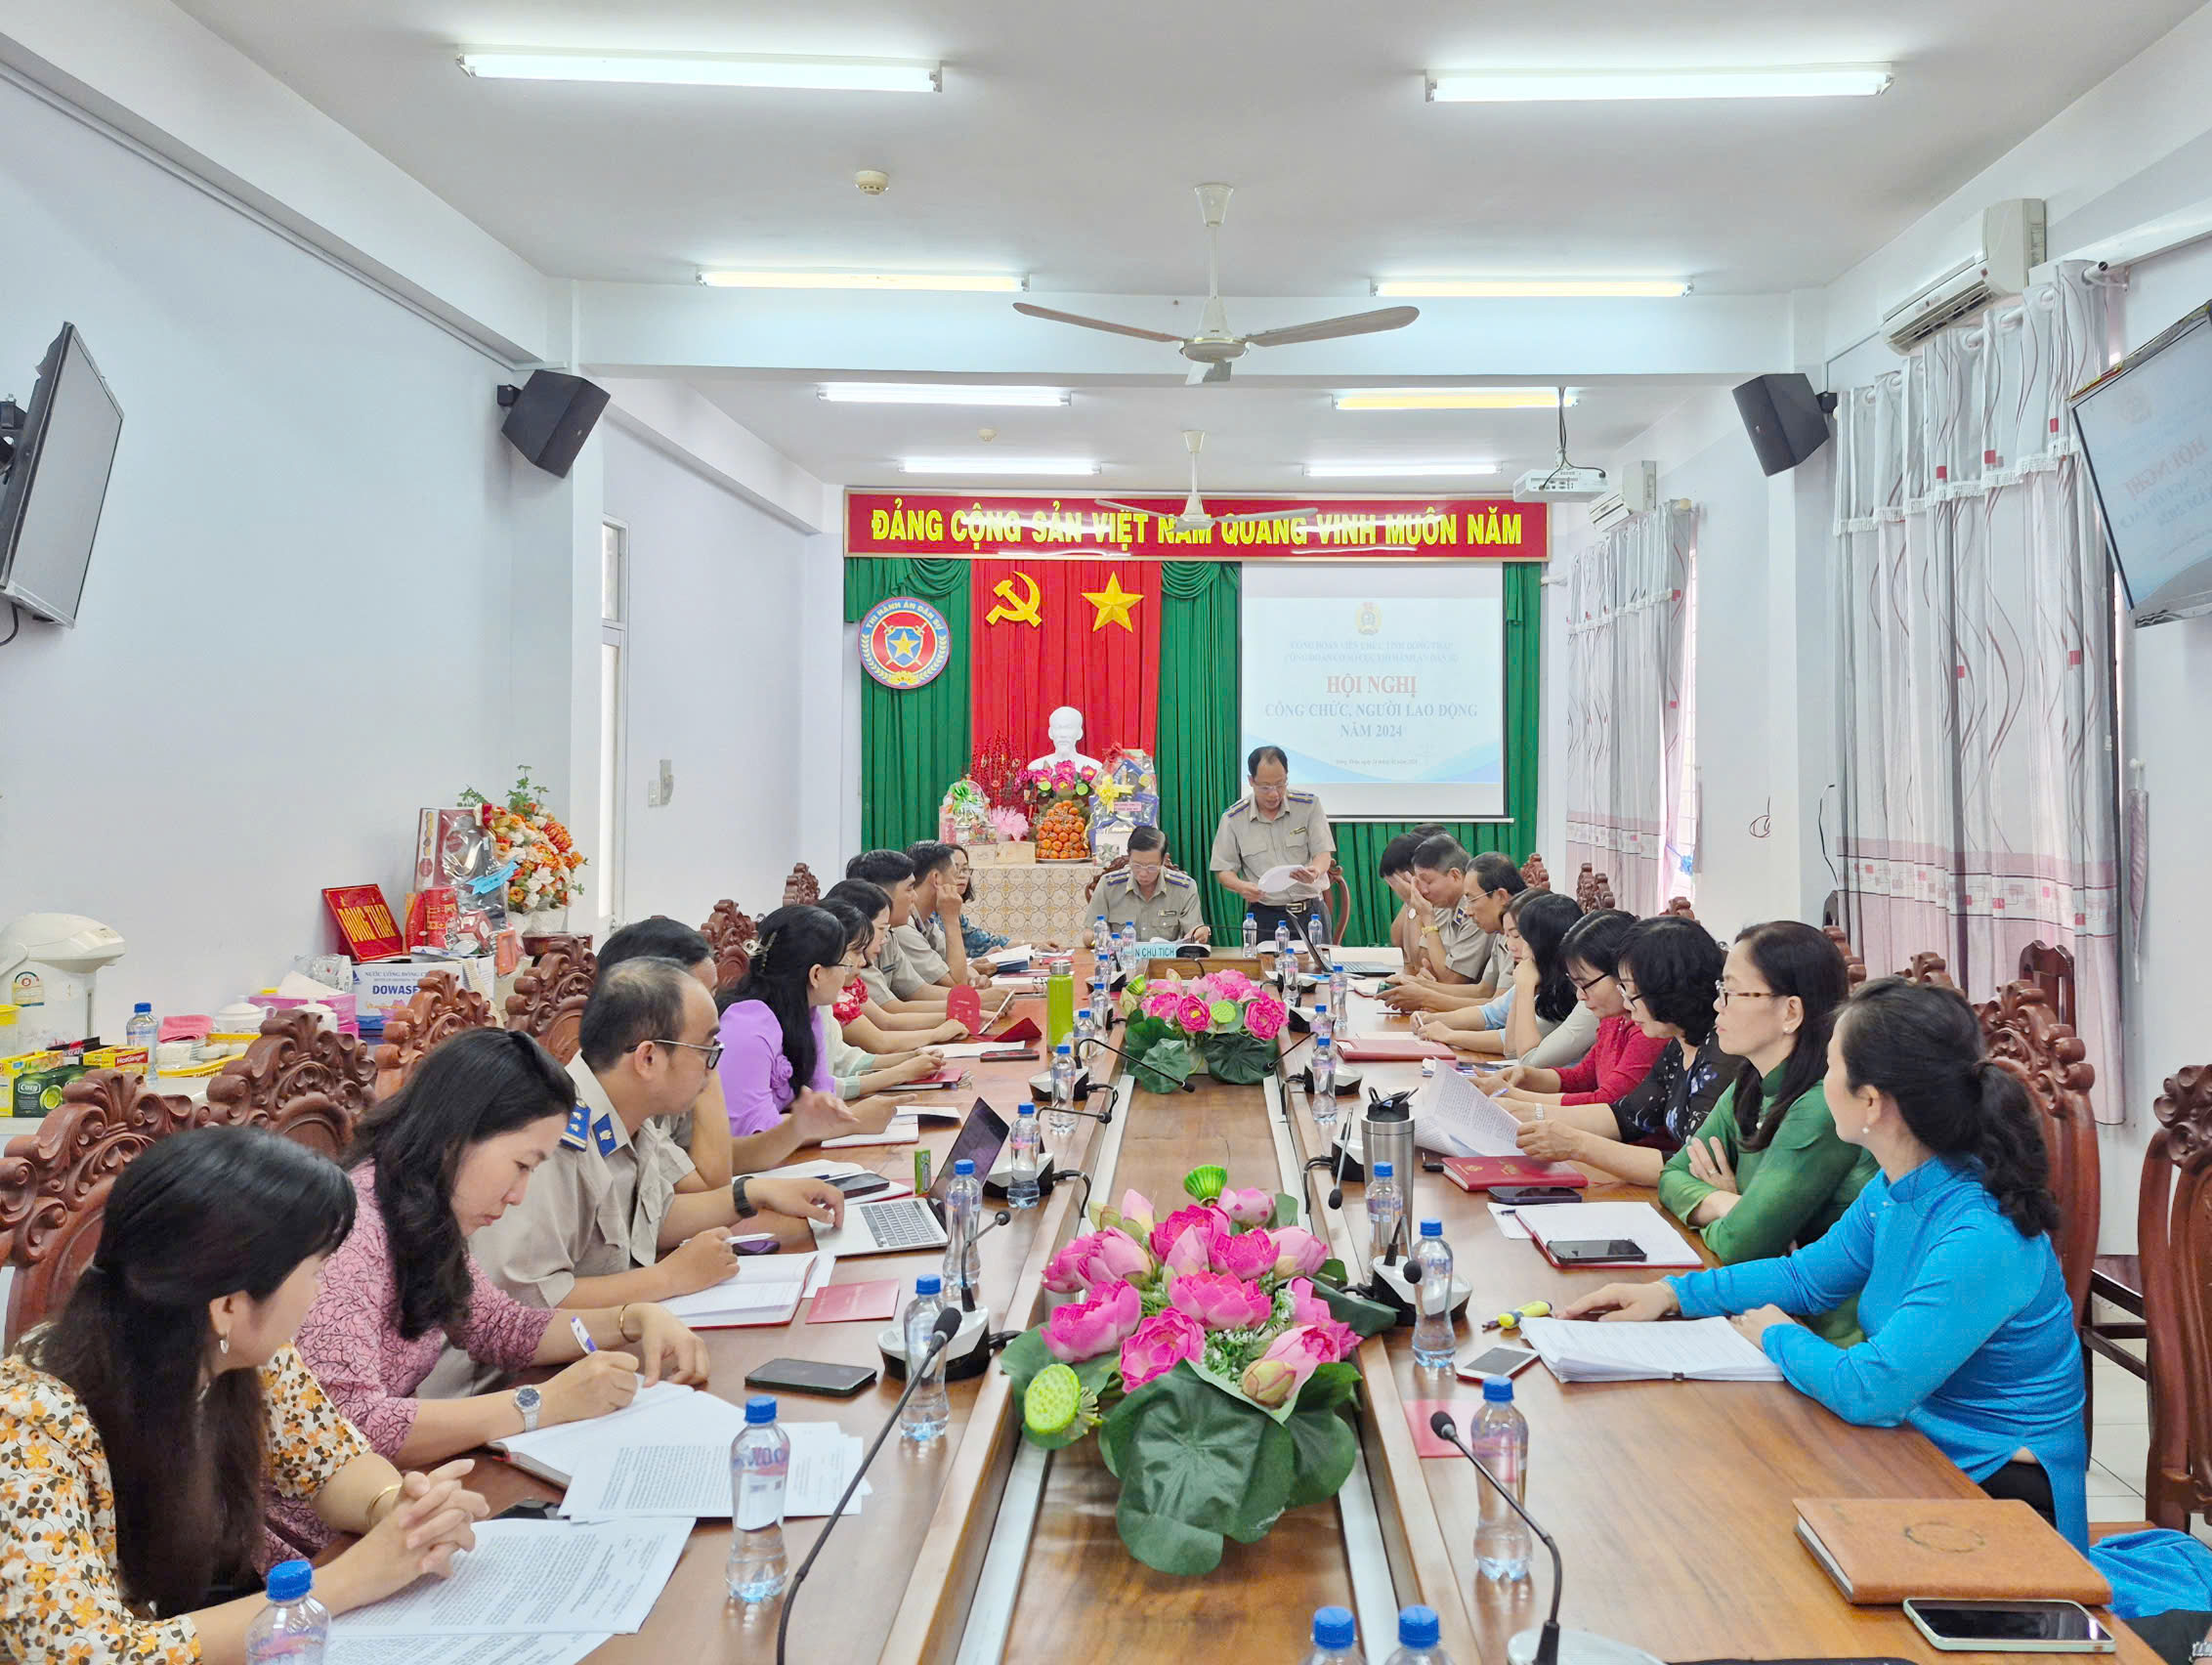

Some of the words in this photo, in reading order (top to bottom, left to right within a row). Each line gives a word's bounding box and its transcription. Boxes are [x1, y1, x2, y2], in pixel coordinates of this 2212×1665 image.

[872, 498, 944, 541] ĐẢNG
[951, 502, 1022, 550] CỘNG
[1032, 500, 1084, 543] SẢN
[1092, 510, 1149, 551] VIỆT
[1221, 512, 1308, 546] QUANG
[1316, 514, 1377, 544] VINH
[1387, 506, 1458, 545] MUÔN
[1468, 506, 1522, 545] NĂM
[1326, 672, 1362, 698] HỘI
[1368, 675, 1417, 698] NGHỊ
[1265, 700, 1305, 718] CÔNG
[1308, 699, 1352, 720] CHỨC,
[1356, 699, 1401, 718] NGƯỜI
[1406, 703, 1434, 718] LAO
[1438, 700, 1478, 720] ĐỘNG
[1340, 721, 1372, 738] NĂM
[1375, 724, 1403, 738] 2024
